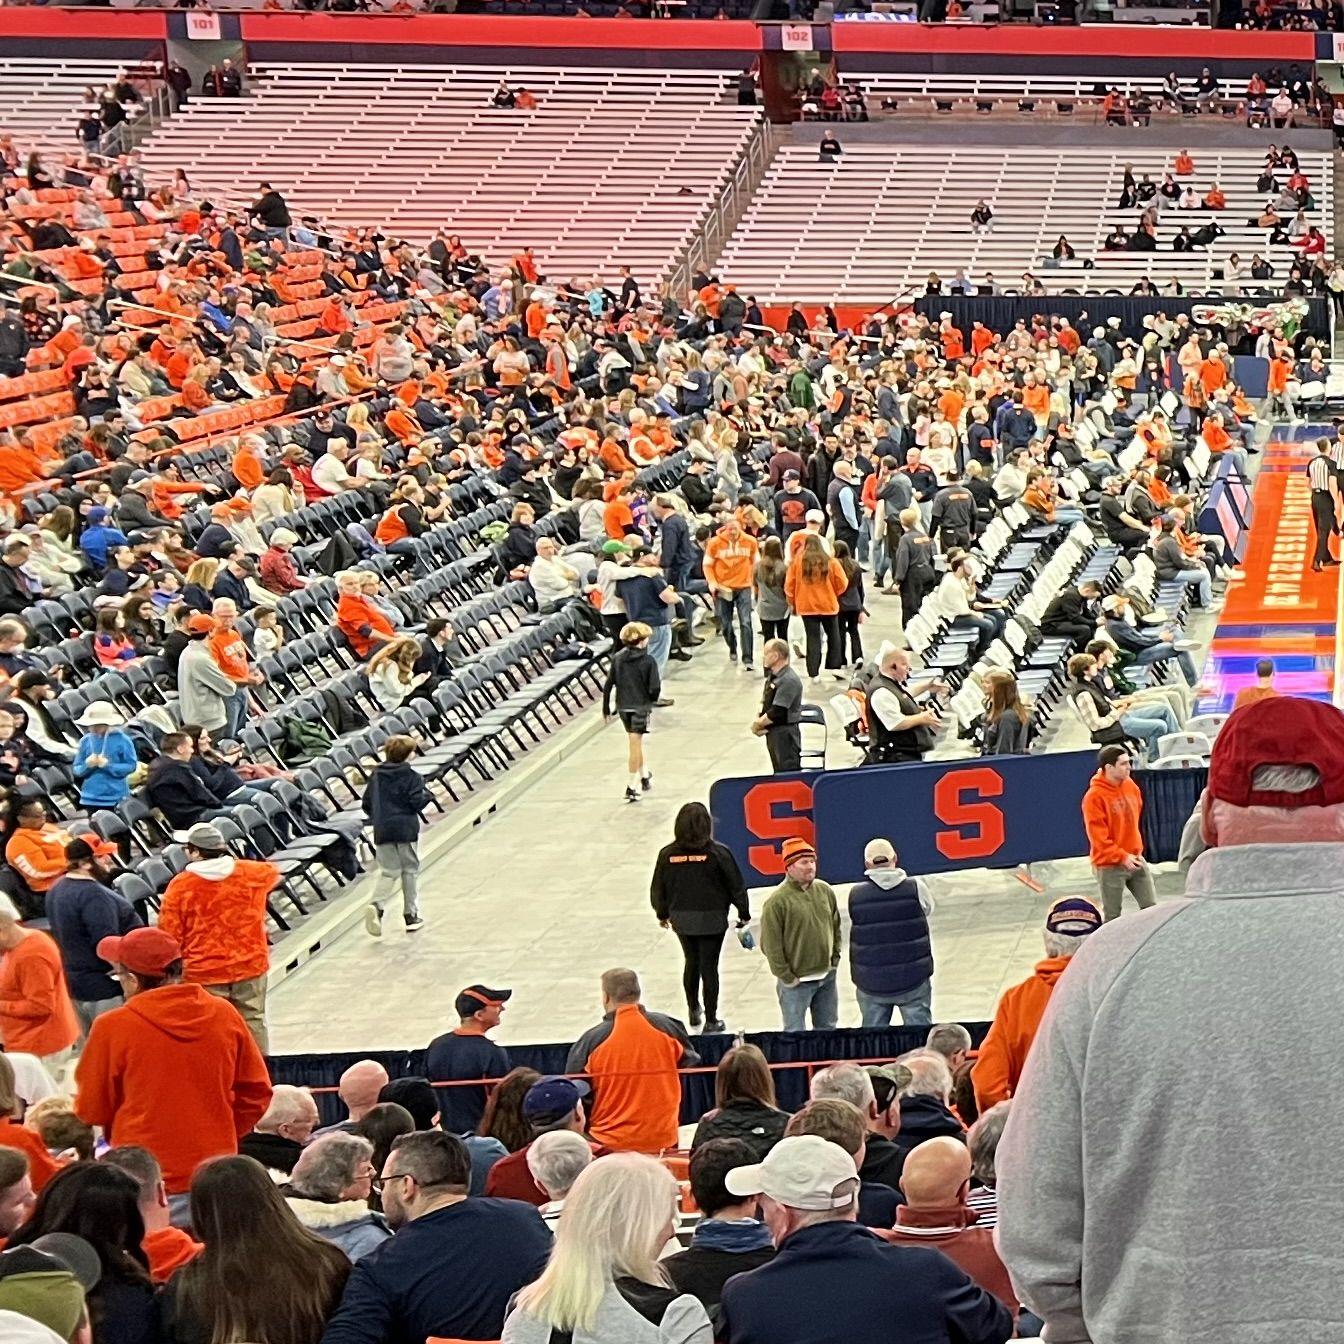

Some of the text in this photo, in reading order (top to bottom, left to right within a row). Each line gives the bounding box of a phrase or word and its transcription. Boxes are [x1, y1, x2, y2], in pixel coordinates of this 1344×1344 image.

[192, 17, 214, 30] 101
[786, 31, 809, 43] 102
[743, 780, 814, 875] S
[933, 767, 1006, 859] S
